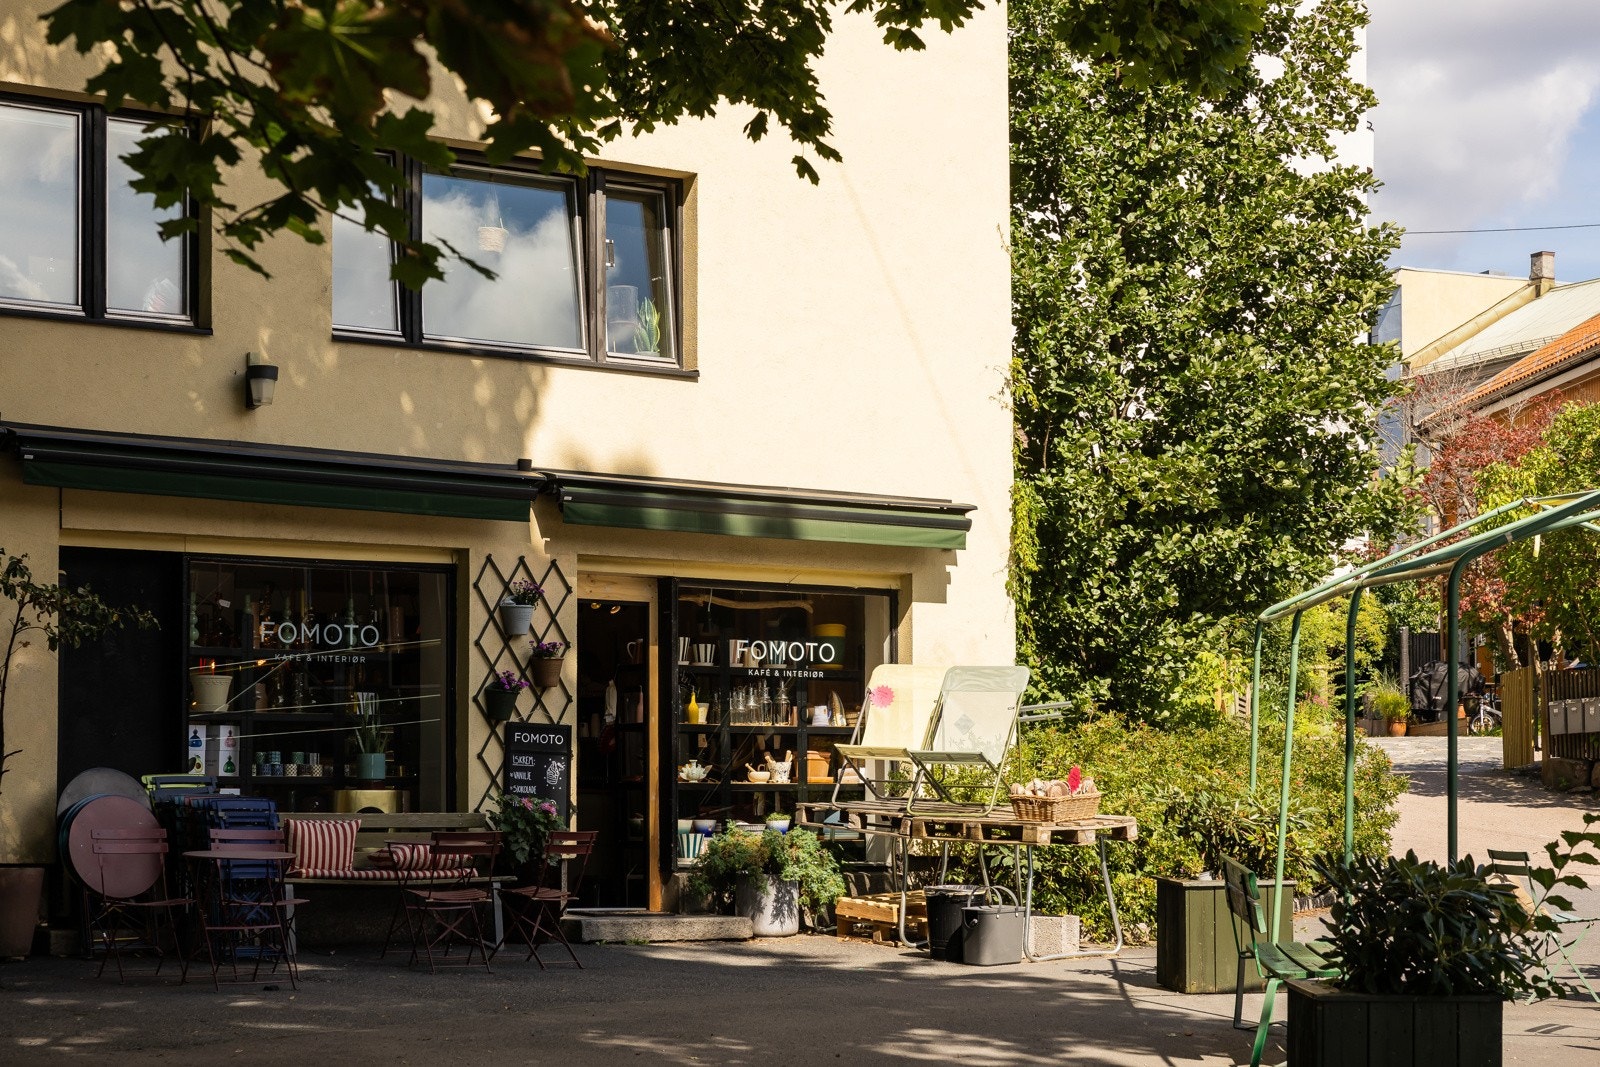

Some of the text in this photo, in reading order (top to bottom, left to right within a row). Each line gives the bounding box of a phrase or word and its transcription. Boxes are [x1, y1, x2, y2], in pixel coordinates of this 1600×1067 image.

[261, 622, 379, 646] FOMOTO
[736, 640, 835, 662] FOMOTO
[306, 654, 312, 662] &
[317, 655, 366, 663] INTERIØR
[748, 669, 771, 677] KAFÉ
[783, 670, 824, 678] INTERIØR
[514, 733, 563, 744] FOMOTO
